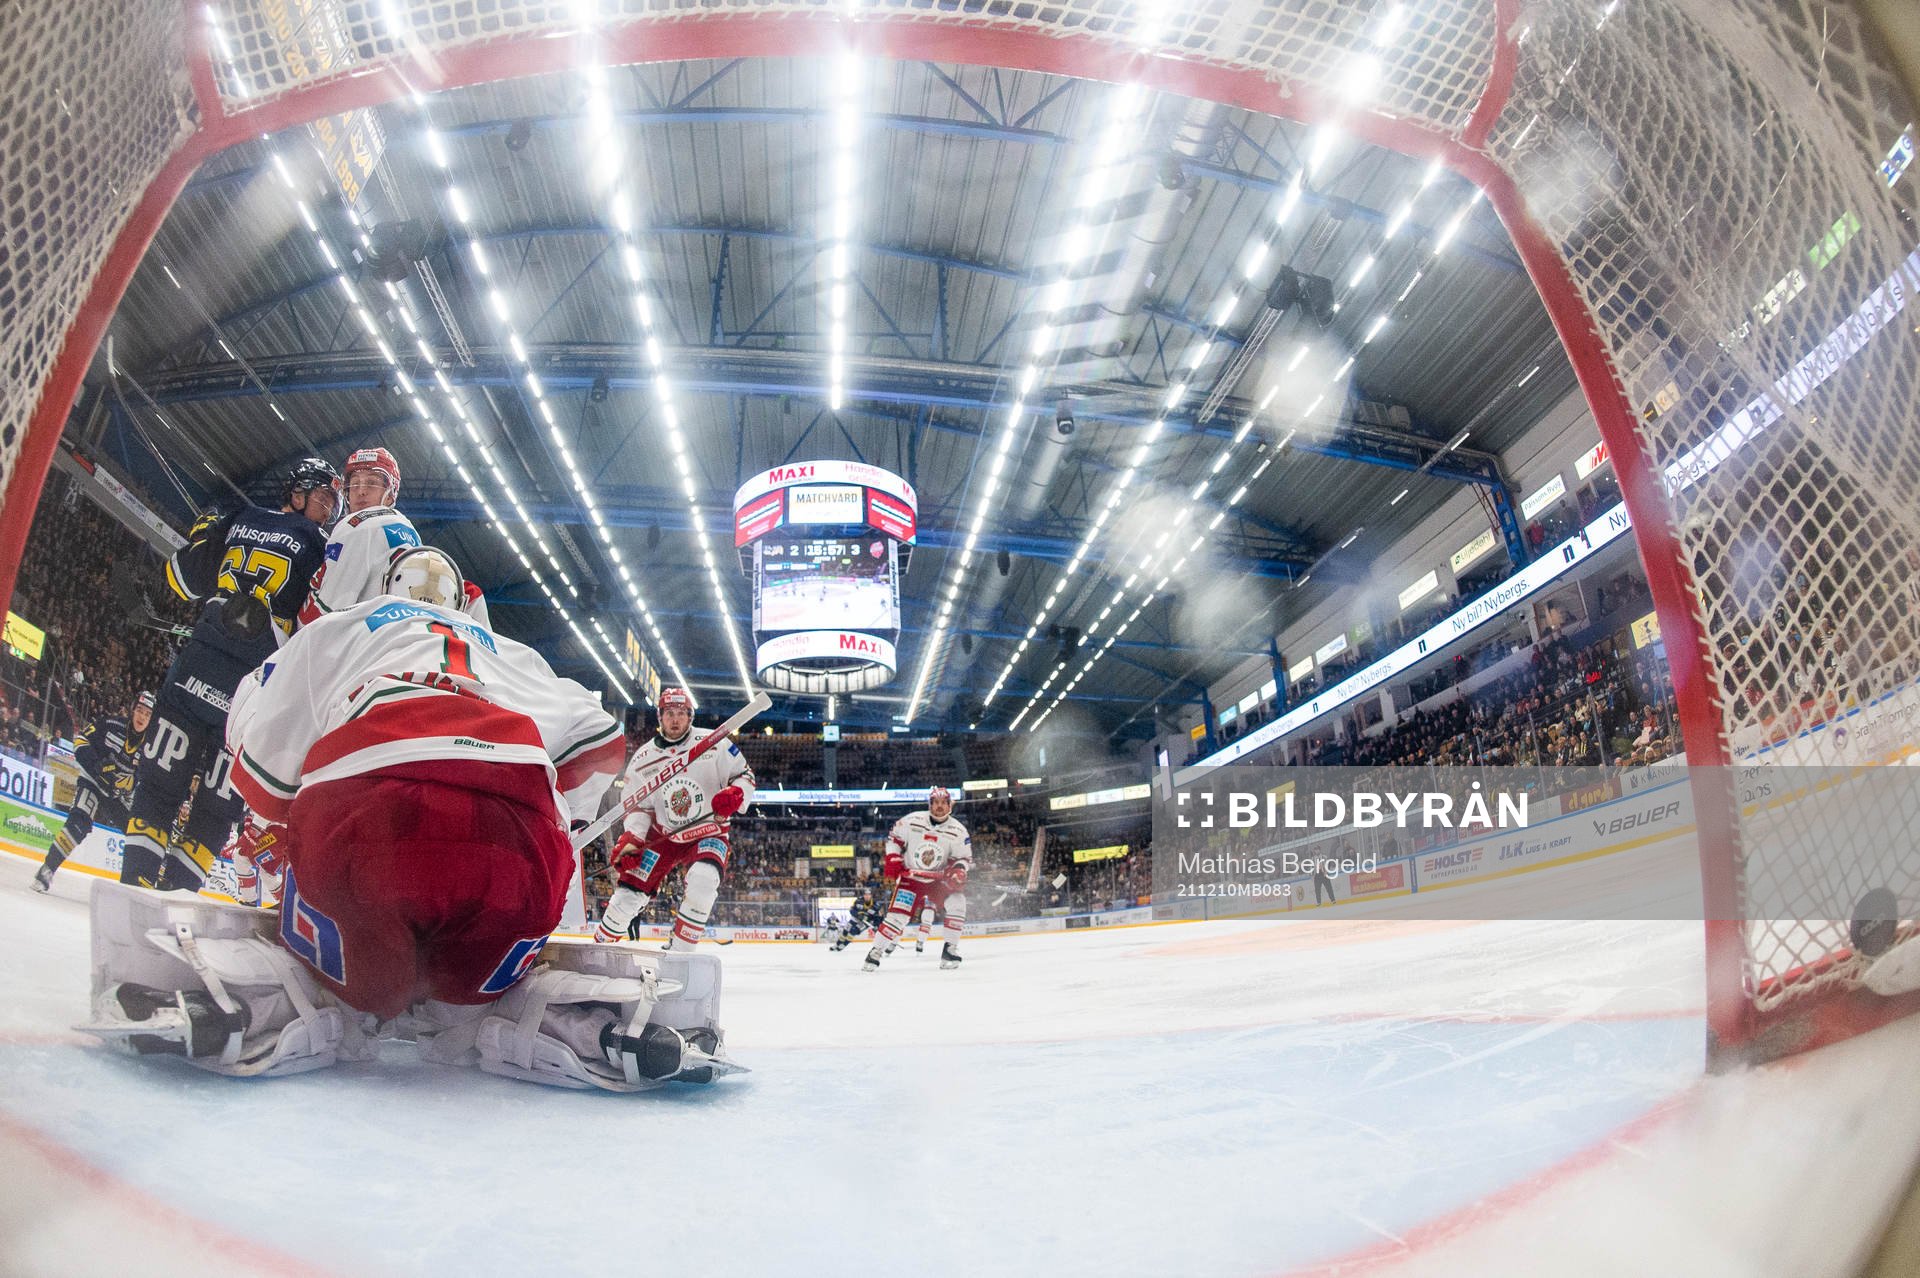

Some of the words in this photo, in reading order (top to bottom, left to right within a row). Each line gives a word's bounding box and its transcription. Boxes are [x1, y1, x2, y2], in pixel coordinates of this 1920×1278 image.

[768, 465, 816, 485] MAXI
[233, 525, 301, 554] Husqvarna
[790, 545, 799, 556] 2
[851, 545, 861, 556] 3
[217, 546, 293, 598] 67
[1452, 614, 1469, 633] Ny
[1466, 602, 1484, 625] bil?
[1483, 578, 1531, 613] Nybergs.
[839, 633, 882, 656] MAXI
[143, 716, 190, 773] JP
[623, 757, 685, 810] BAUER
[1608, 800, 1681, 835] BAUER
[682, 824, 717, 841] KVANTUM
[1549, 835, 1572, 849] KRAFT
[1434, 850, 1472, 870] HOLST
